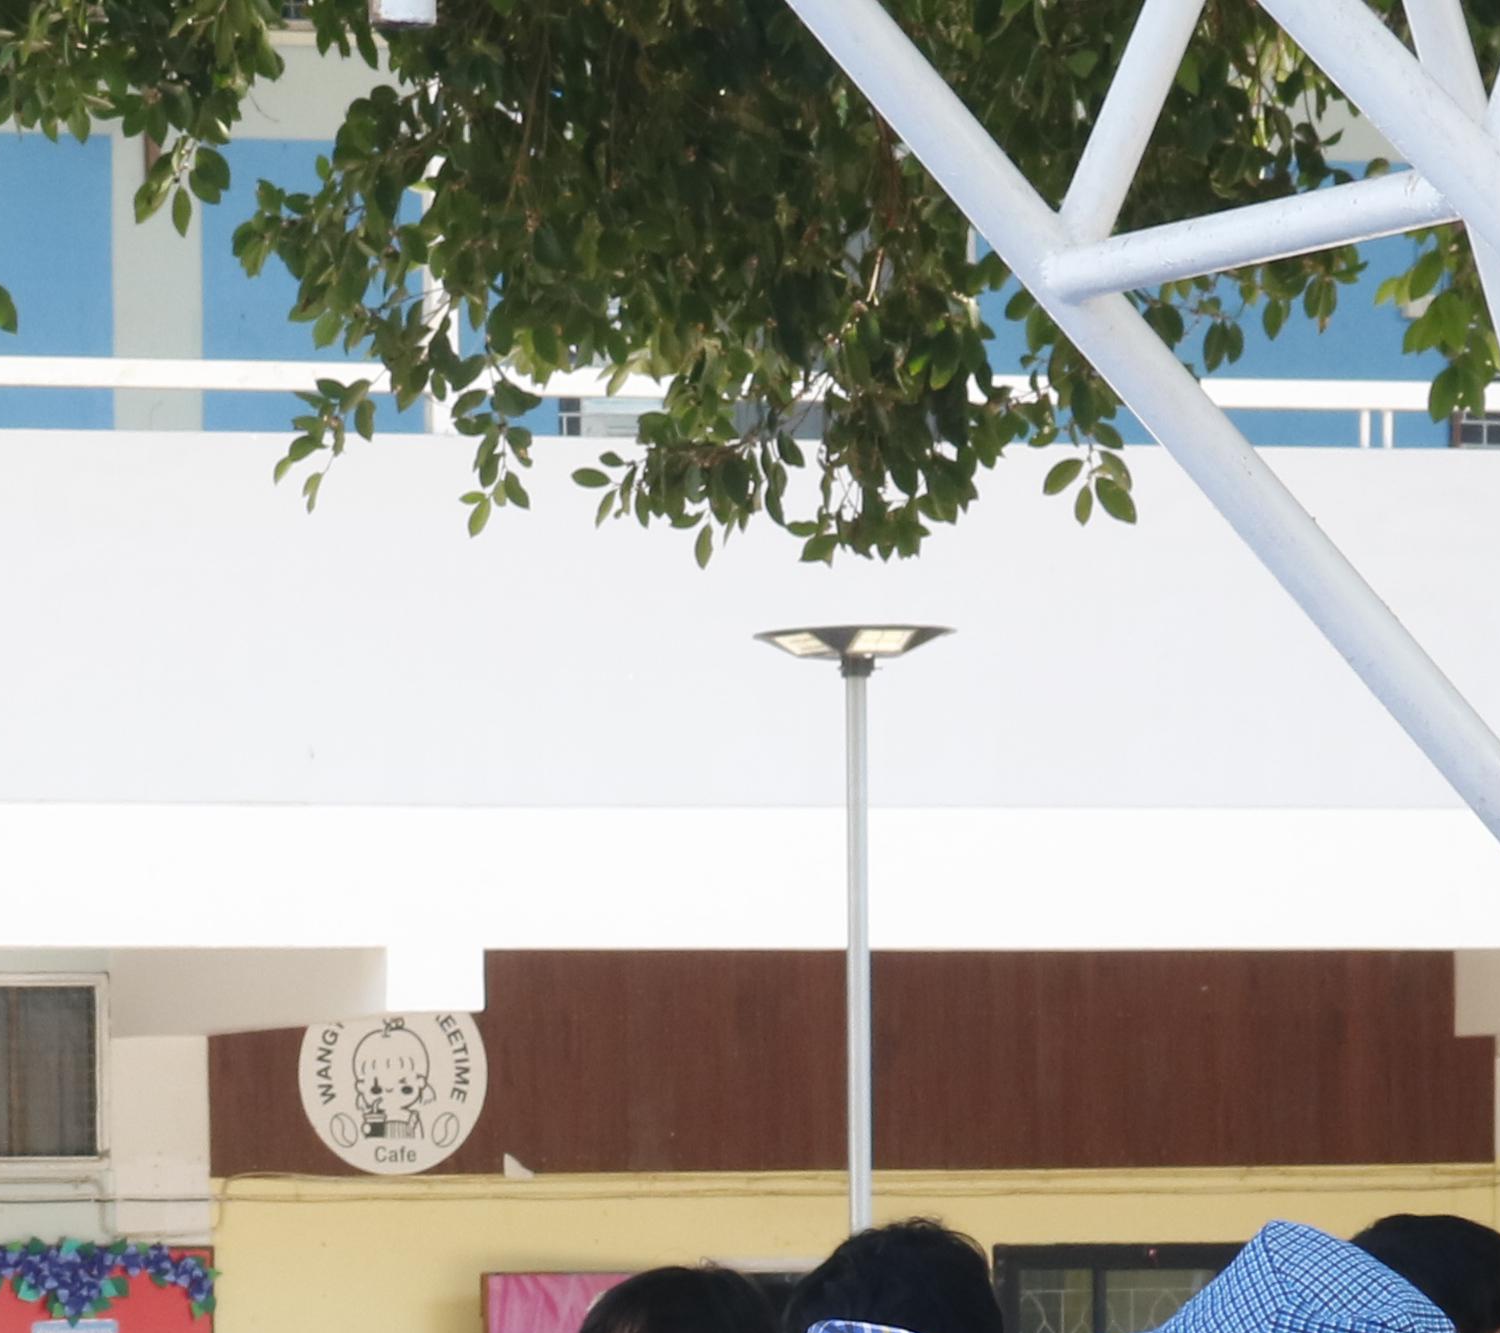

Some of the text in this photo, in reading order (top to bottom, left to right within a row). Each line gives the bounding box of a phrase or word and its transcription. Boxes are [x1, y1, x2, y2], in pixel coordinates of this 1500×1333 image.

[316, 1021, 345, 1105] WANG
[435, 1014, 471, 1104] EETIME
[374, 1146, 417, 1163] Cafe
